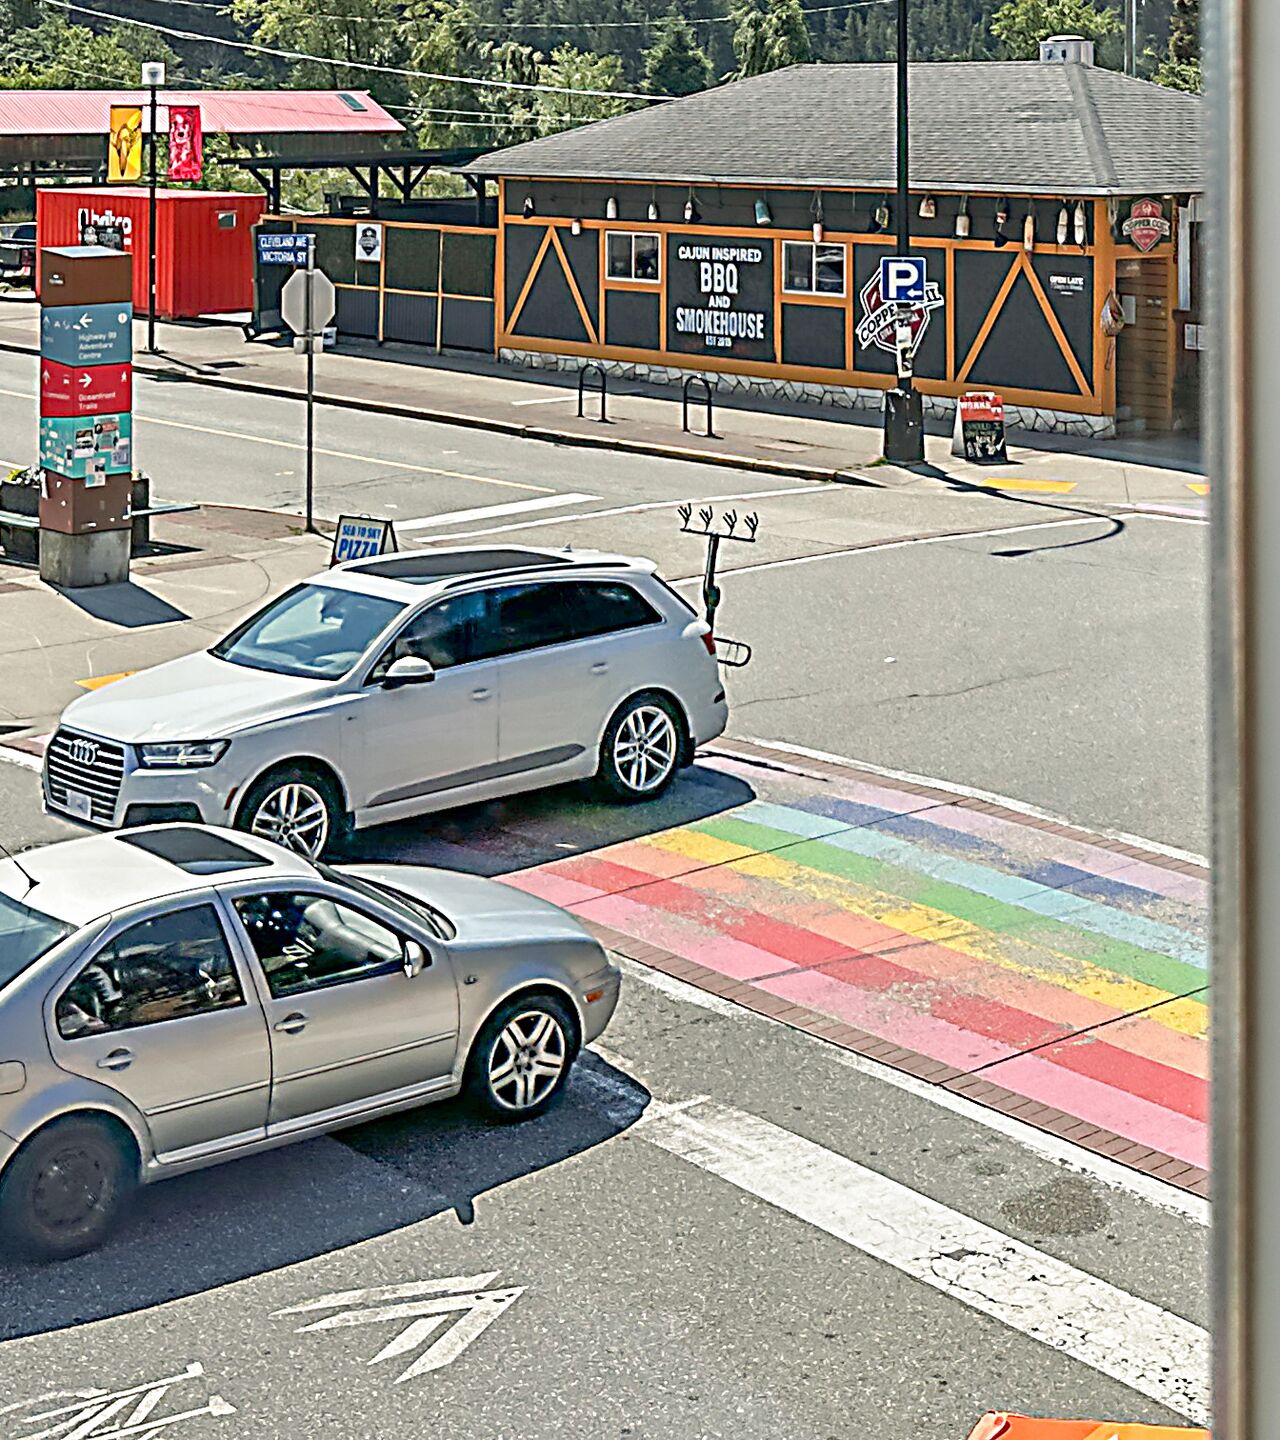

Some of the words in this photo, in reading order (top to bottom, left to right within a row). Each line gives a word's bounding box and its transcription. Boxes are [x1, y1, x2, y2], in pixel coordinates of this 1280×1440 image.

[261, 237, 295, 248] CLEVELAND
[262, 251, 295, 262] VICTORIA
[297, 252, 307, 262] ST
[678, 246, 710, 260] CAJUN
[712, 247, 762, 263] INSPIRED
[700, 262, 739, 294] BBQ
[888, 262, 919, 299] P
[708, 295, 731, 308] AND
[676, 307, 764, 339] SMOKEHOUSE
[860, 303, 897, 343] COPPE
[342, 525, 355, 536] SEA
[357, 526, 367, 537] TO
[368, 527, 382, 539] SKY
[337, 538, 378, 560] PIZZA
